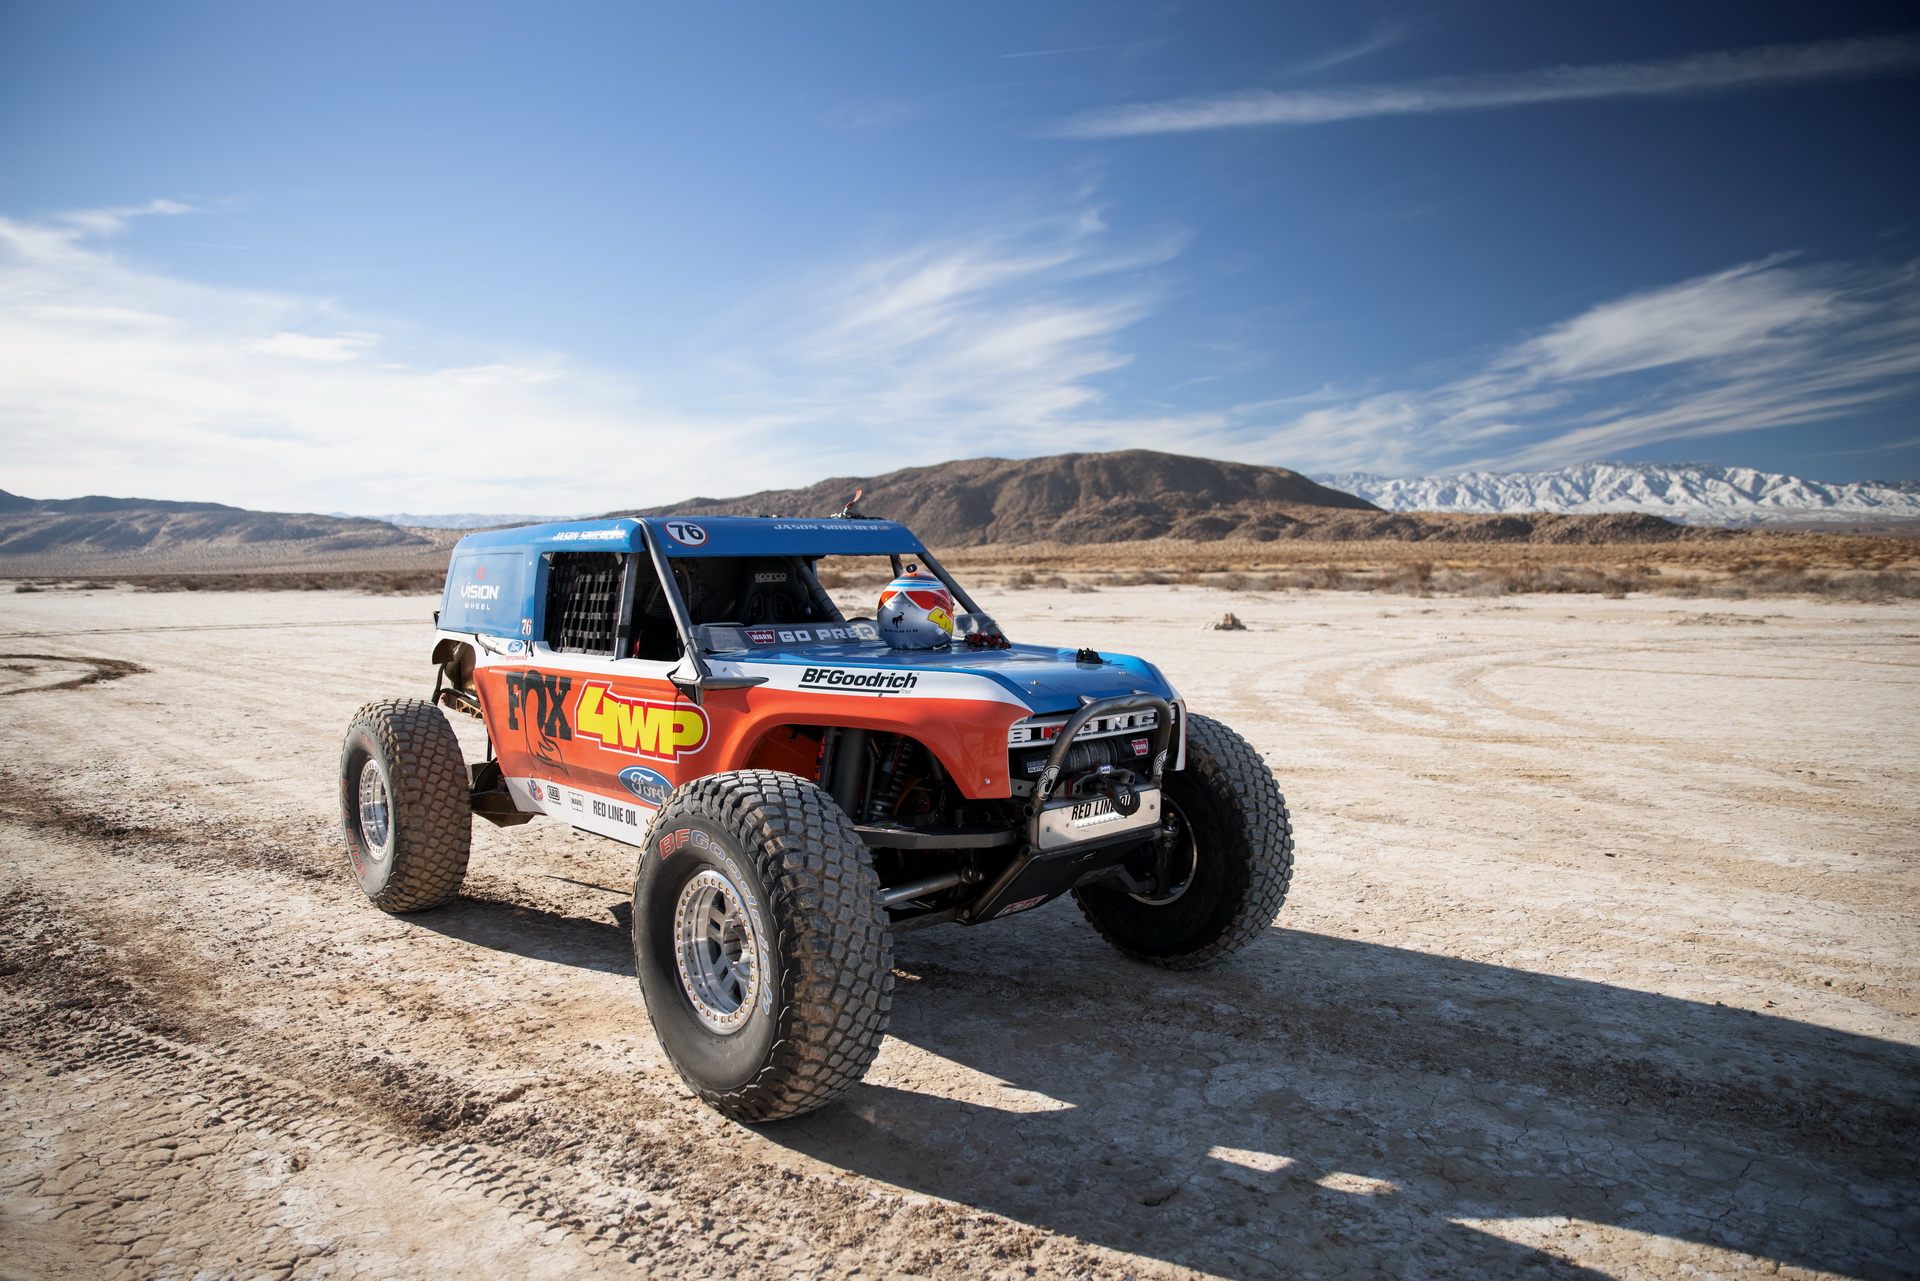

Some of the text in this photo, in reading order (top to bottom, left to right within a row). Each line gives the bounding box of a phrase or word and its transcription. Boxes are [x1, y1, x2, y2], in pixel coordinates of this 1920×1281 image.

[553, 532, 580, 541] JASON
[667, 524, 704, 540] 76
[755, 572, 786, 581] sparco
[461, 583, 498, 600] VISION
[464, 602, 491, 611] WHEEL
[521, 618, 532, 636] 76
[751, 633, 773, 641] WARN
[778, 629, 811, 643] GO
[801, 668, 918, 688] BFGoodrich
[506, 670, 572, 745] FOX
[577, 686, 704, 756] 4WP
[630, 771, 666, 801] Ford
[593, 800, 607, 817] RED
[608, 806, 624, 823] LINE
[625, 809, 638, 827] OIL
[1071, 803, 1092, 821] RED
